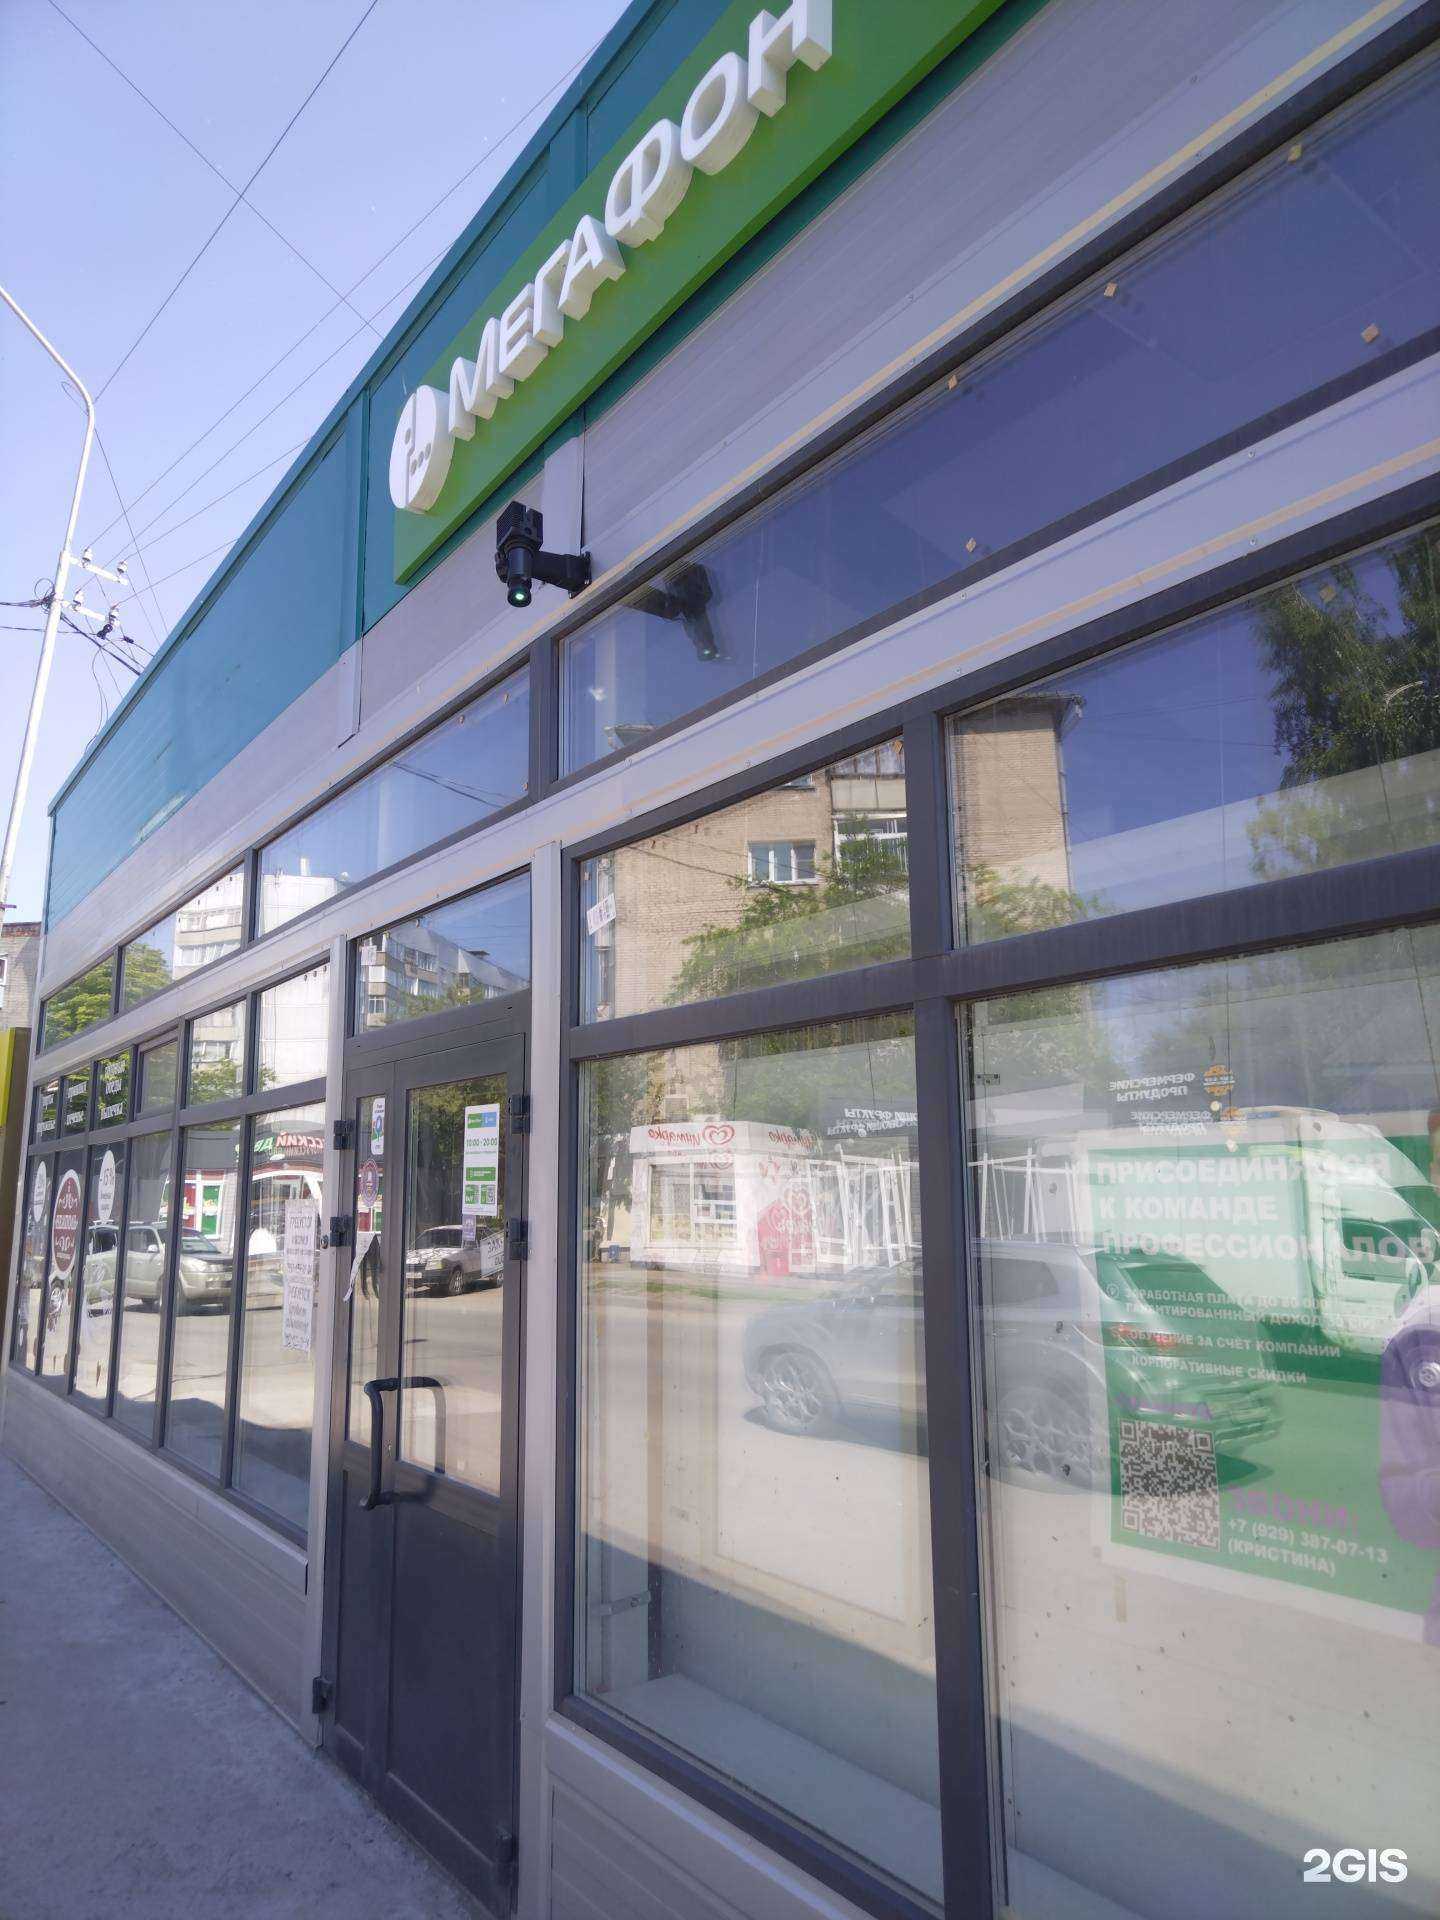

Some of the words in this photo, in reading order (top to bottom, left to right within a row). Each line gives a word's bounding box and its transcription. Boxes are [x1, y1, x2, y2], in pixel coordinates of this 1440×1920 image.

[449, 0, 832, 441] МЕГАФОН
[1099, 1197, 1116, 1219] К
[1125, 1195, 1280, 1226] КОМАНДЕ
[1102, 1230, 1436, 1264] ПРОФЕССИОНЛОВ
[1130, 1328, 1194, 1346] ОБУЧЕНИЕ
[1198, 1335, 1213, 1348] ЗА
[1256, 1338, 1341, 1358] КОМПАНИИ
[1131, 1354, 1244, 1378] КОРПОРАТИВНЫЕ
[1248, 1367, 1307, 1384] СКИДКИ
[1227, 1518, 1248, 1532] +7
[1252, 1522, 1295, 1547] (929)
[1227, 1538, 1337, 1578] (КРИСТИНА)
